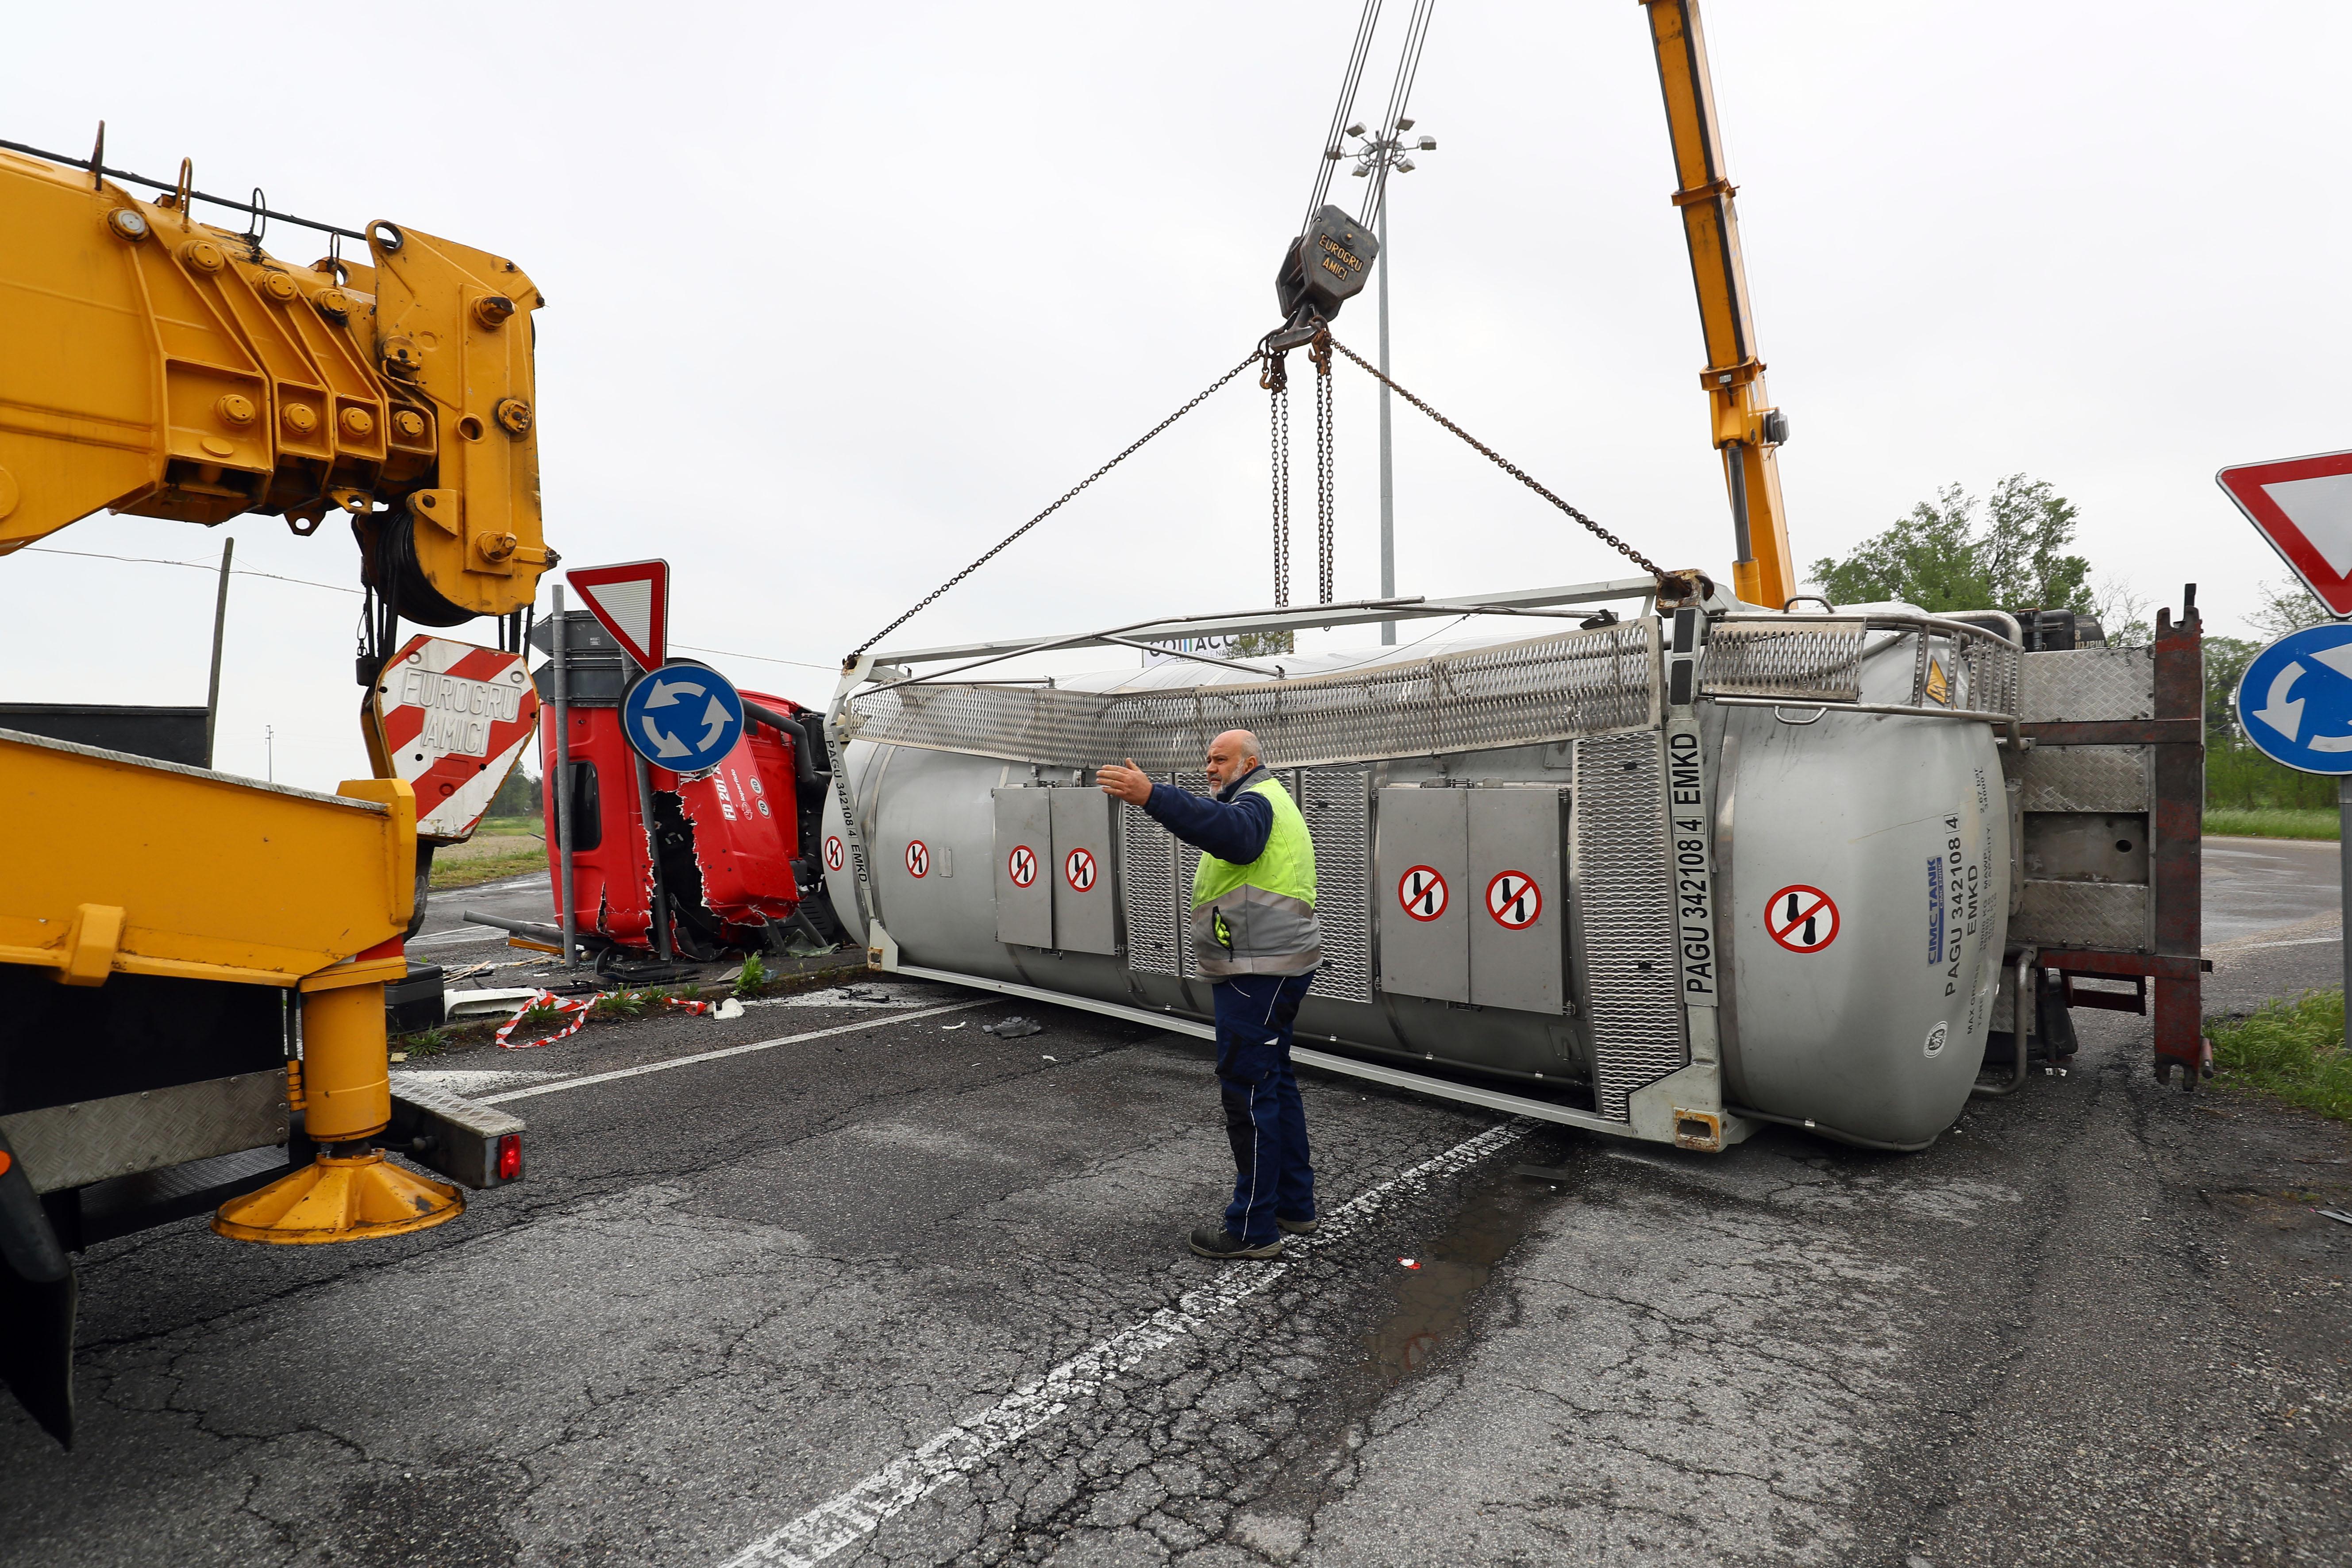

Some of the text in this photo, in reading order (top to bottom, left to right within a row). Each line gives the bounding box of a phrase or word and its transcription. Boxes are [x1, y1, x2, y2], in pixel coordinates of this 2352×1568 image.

[1319, 235, 1363, 272] EUROGRU
[1322, 258, 1347, 280] AMICI
[402, 667, 521, 720] EUROGRU
[422, 714, 490, 755] AMICI
[715, 779, 730, 801] 201
[752, 781, 759, 791] 80
[760, 803, 767, 813] 70
[826, 740, 842, 778] PAGU
[836, 782, 854, 826] 342108
[851, 844, 867, 882] EMKD
[1671, 733, 1713, 993] PAGU 342108 4 EMKD
[1927, 859, 1937, 965] CIMC TANK
[1945, 817, 1963, 997] PAGU 342108 4
[1967, 865, 1978, 936] EMKD
